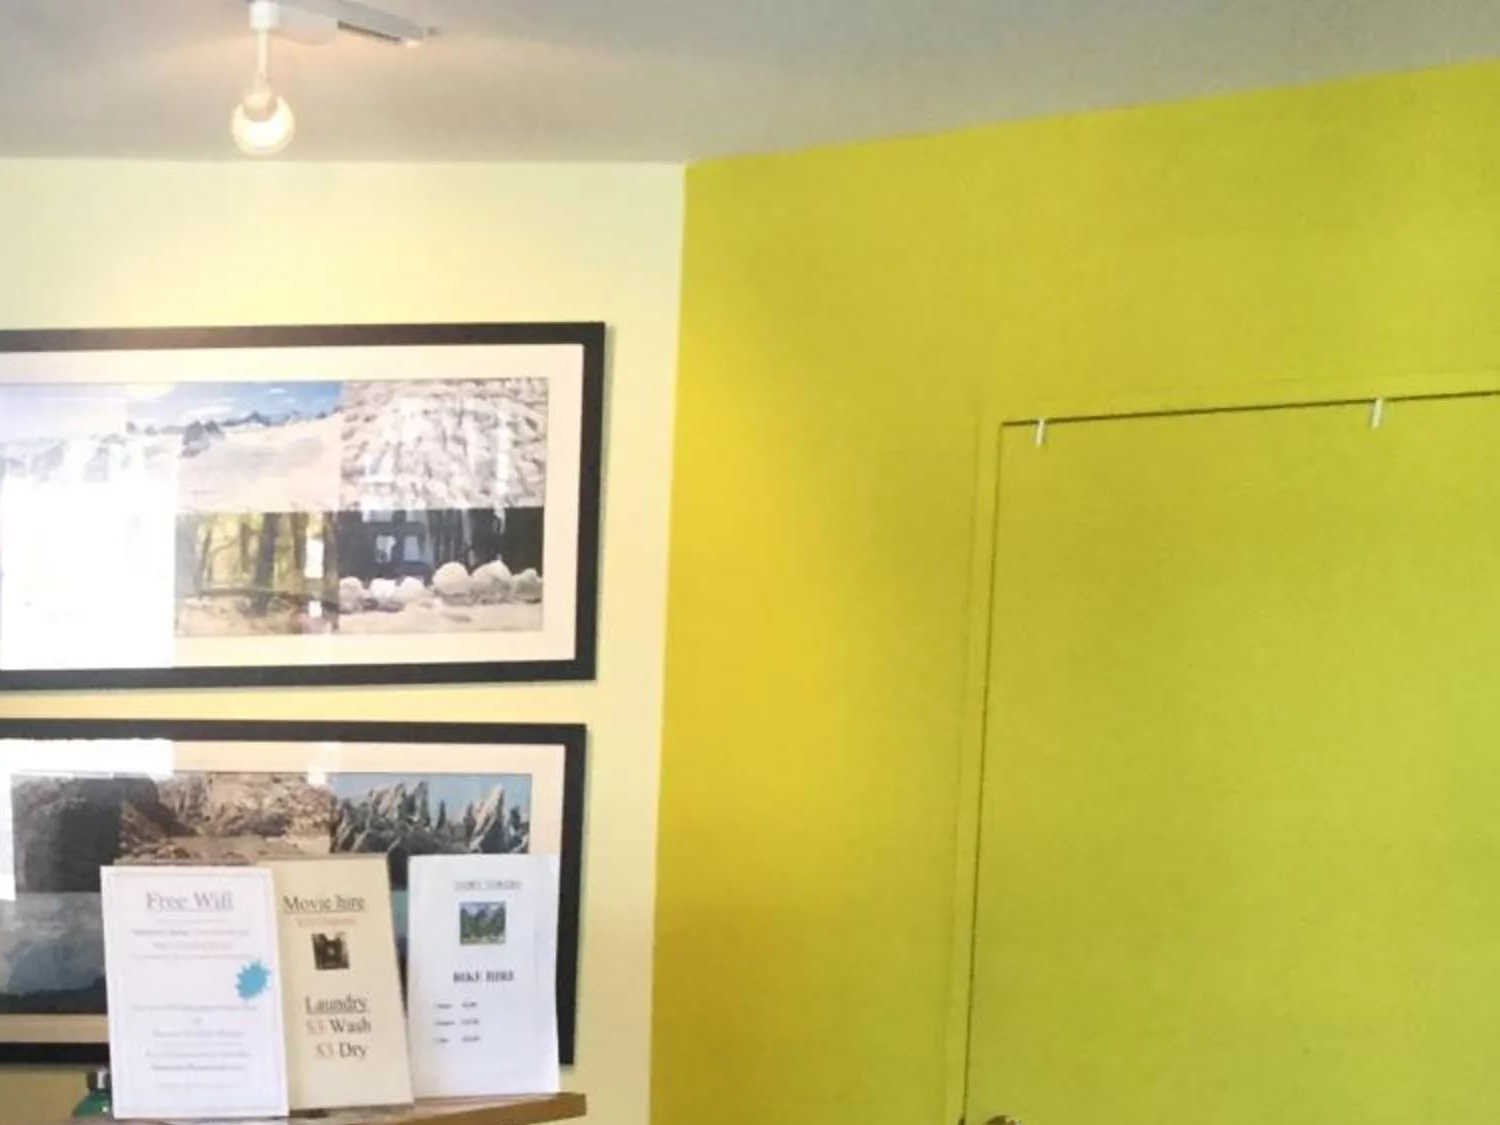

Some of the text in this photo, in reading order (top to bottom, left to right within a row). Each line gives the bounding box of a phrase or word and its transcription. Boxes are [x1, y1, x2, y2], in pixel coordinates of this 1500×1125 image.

[146, 890, 188, 911] Free
[283, 895, 331, 913] Movie
[304, 994, 368, 1015] Laundry
[329, 1016, 372, 1035] Wash
[339, 1041, 367, 1059] Dry
